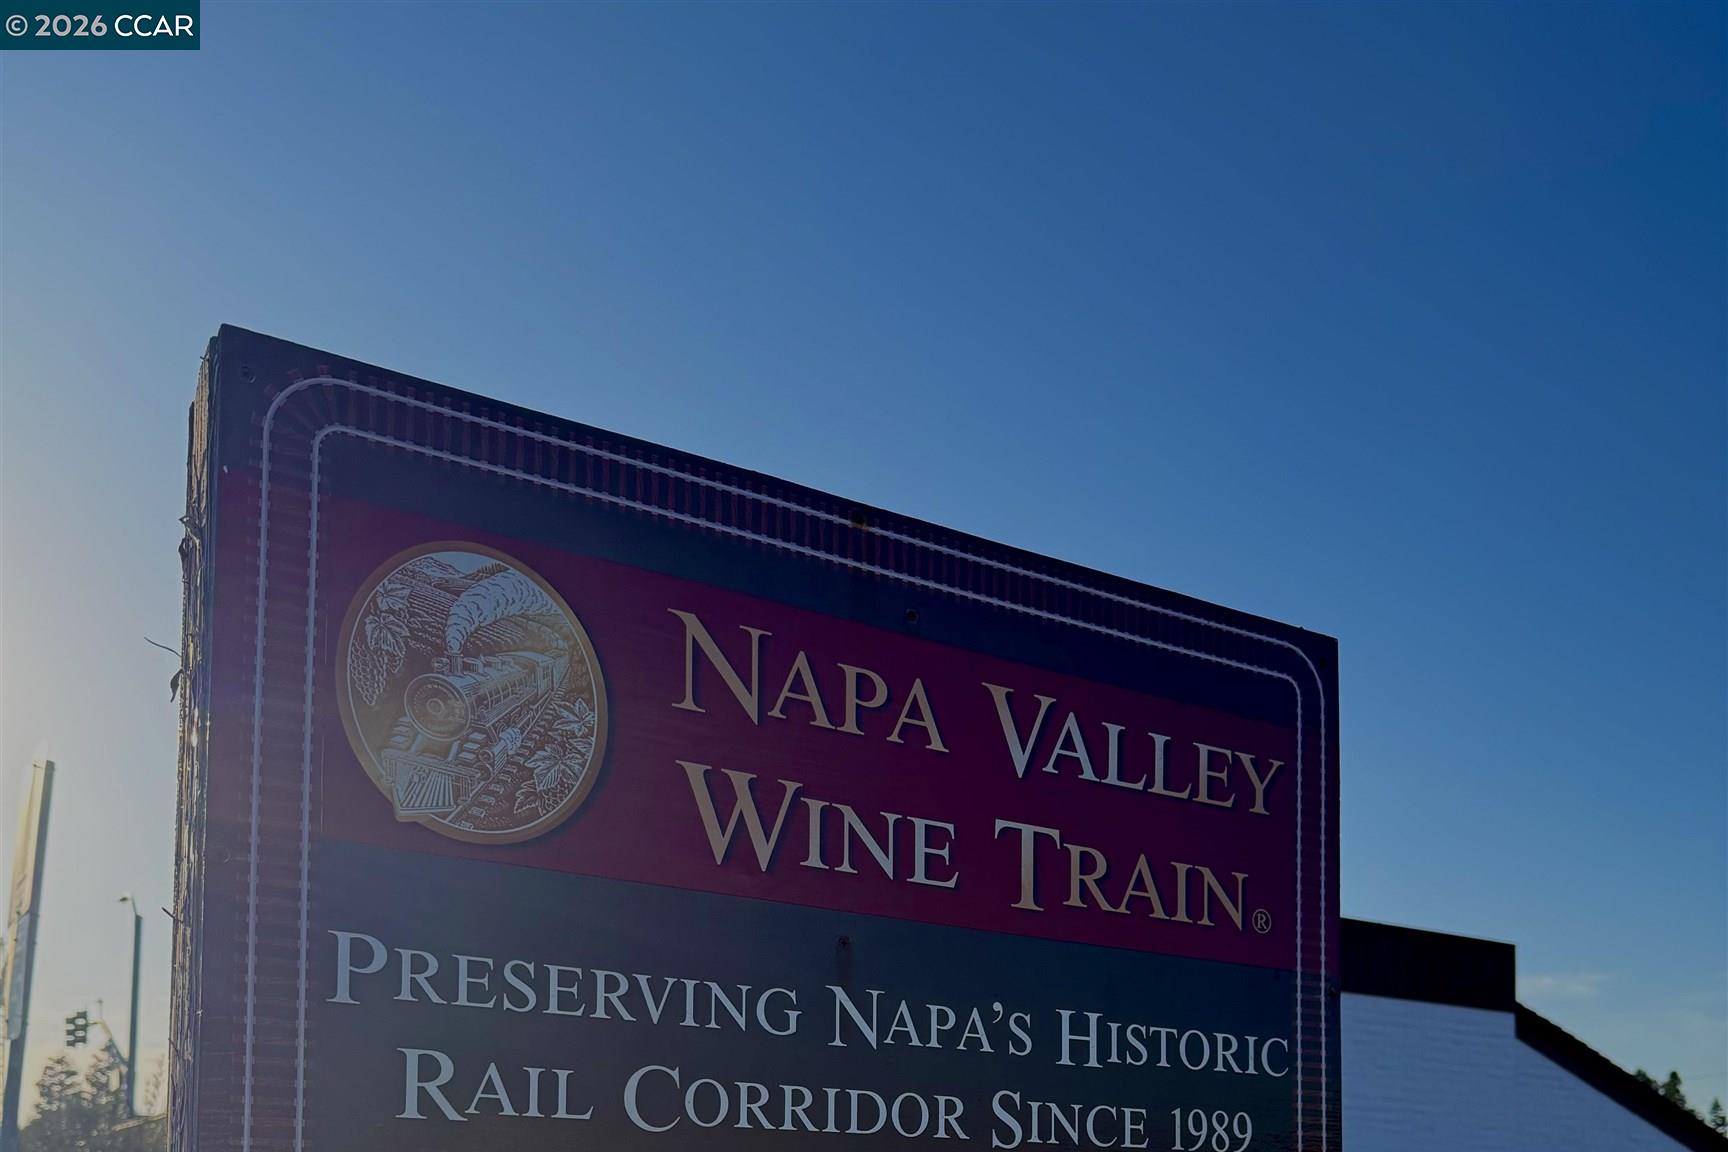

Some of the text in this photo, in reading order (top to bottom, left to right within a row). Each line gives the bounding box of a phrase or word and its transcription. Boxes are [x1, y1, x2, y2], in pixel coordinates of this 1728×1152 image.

[667, 608, 1285, 816] NAPA VALLEY
[675, 760, 960, 889] WINE
[326, 929, 803, 1036] PRESERVING
[1055, 1008, 1290, 1078] HISTORIC
[395, 1047, 594, 1122] RAIL
[623, 1064, 971, 1140] CORRIDOR
[991, 1089, 1150, 1150] SINCE
